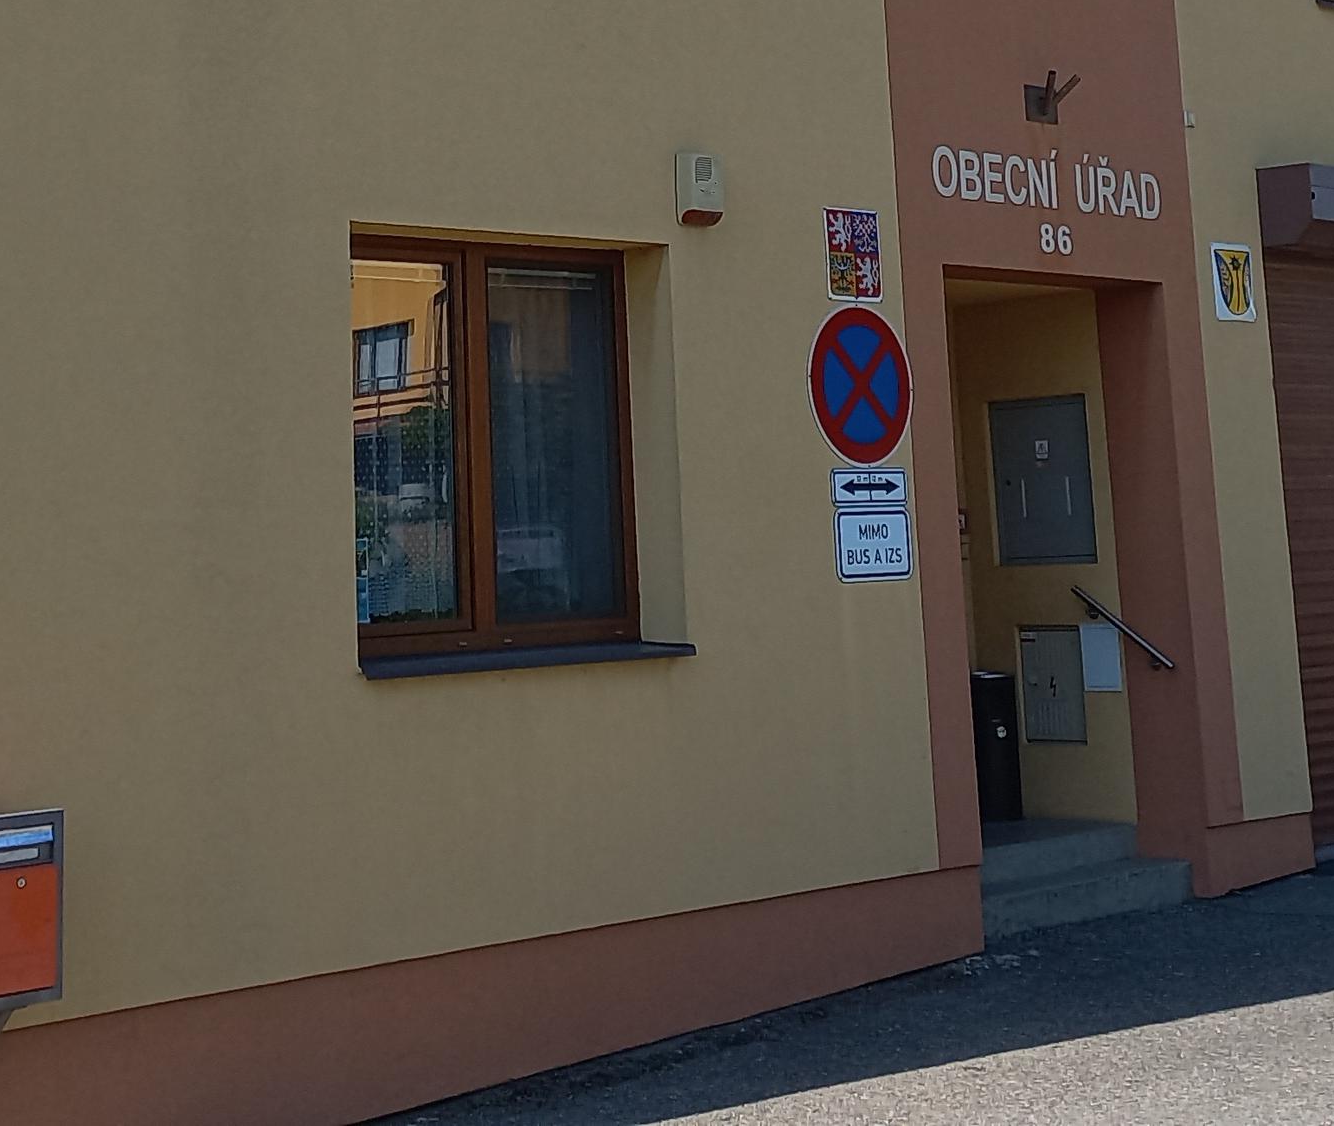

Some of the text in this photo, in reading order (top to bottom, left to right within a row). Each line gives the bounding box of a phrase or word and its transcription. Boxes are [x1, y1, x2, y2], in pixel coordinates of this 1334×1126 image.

[932, 144, 1162, 220] OBECNÍ ÚŘAD
[1040, 223, 1073, 255] 86
[858, 523, 889, 540] MIMO
[847, 547, 903, 565] BUS A IZS
